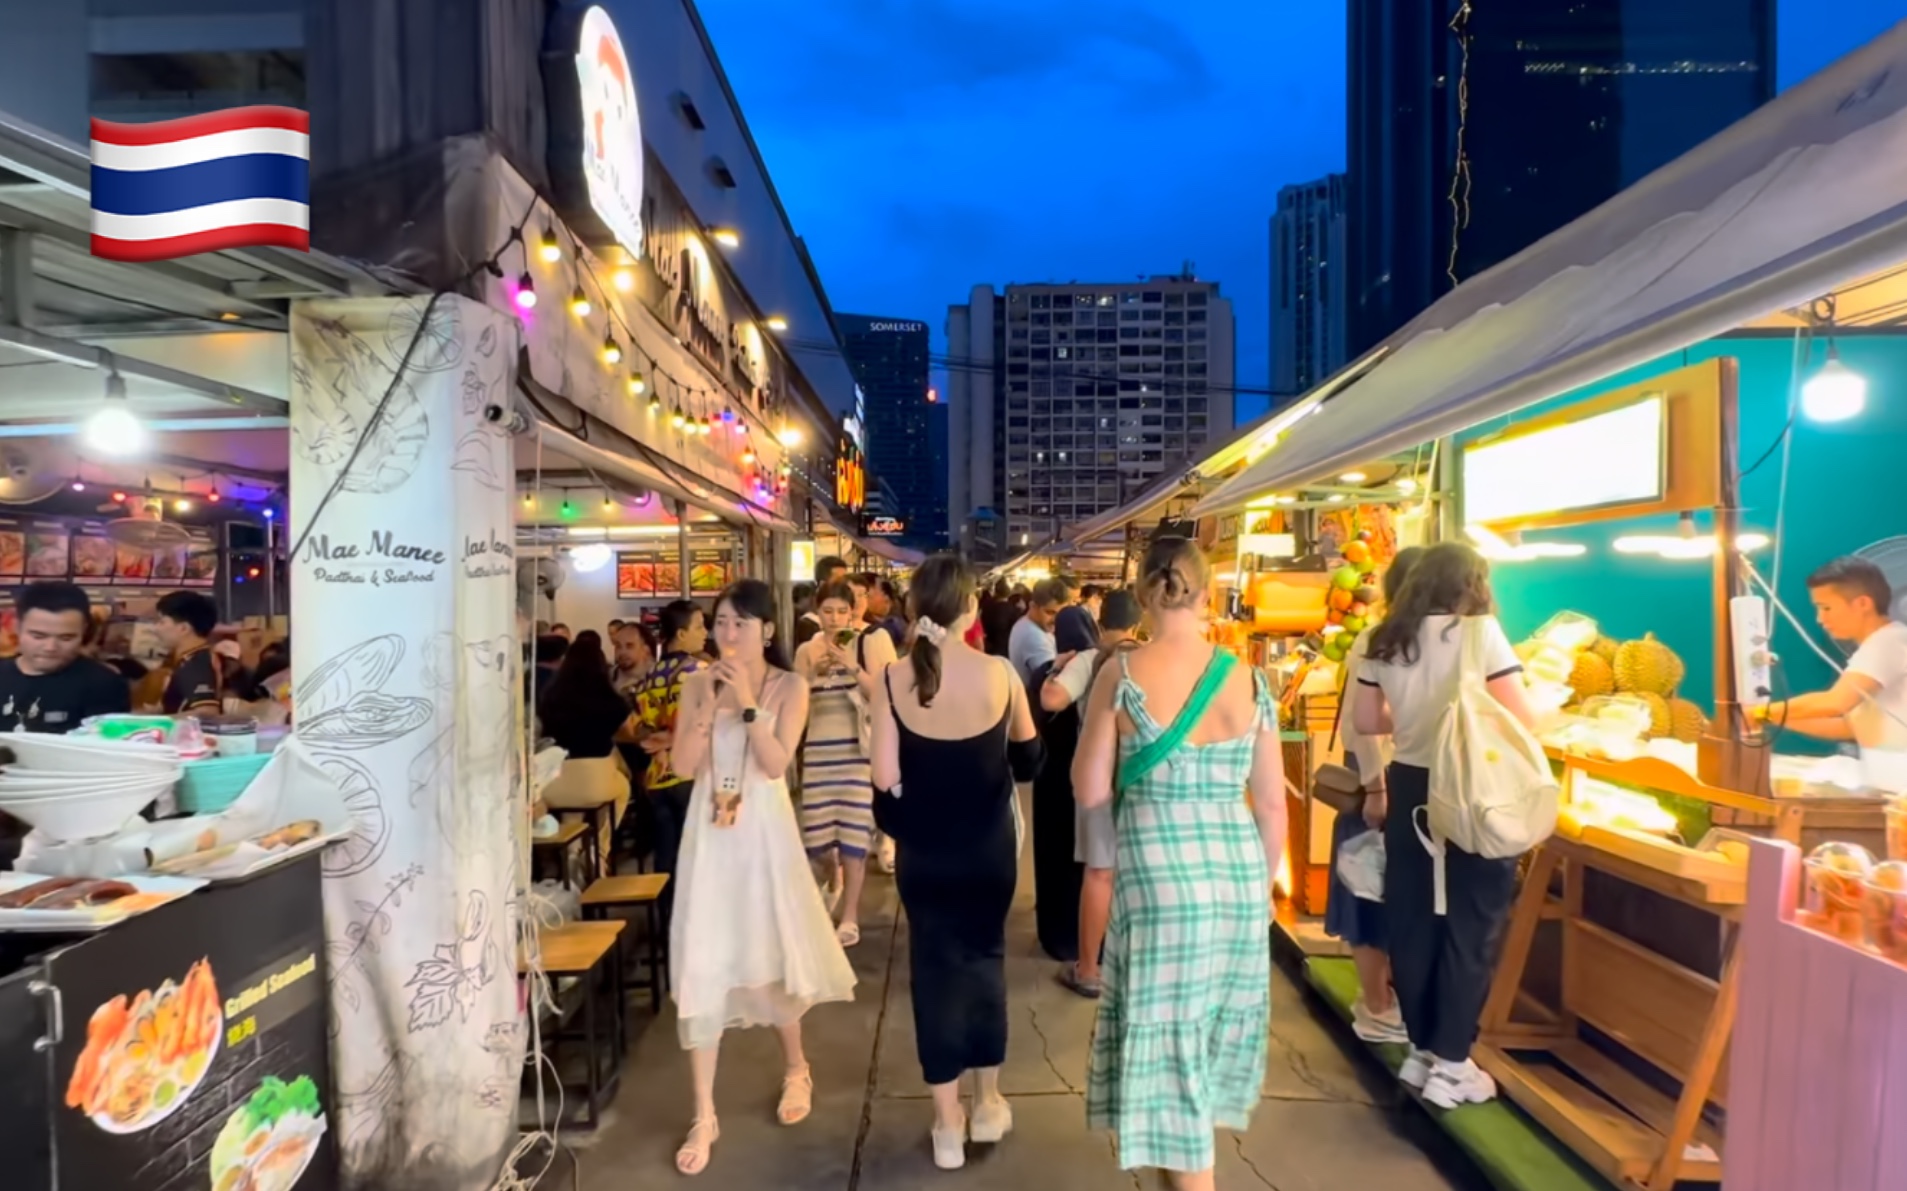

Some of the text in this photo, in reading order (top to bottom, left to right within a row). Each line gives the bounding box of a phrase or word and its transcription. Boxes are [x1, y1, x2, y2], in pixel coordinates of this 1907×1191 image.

[870, 322, 922, 332] SOMERSET
[302, 530, 446, 565] Mae Manee
[313, 567, 365, 584] Padthai
[383, 569, 434, 584] Seafood
